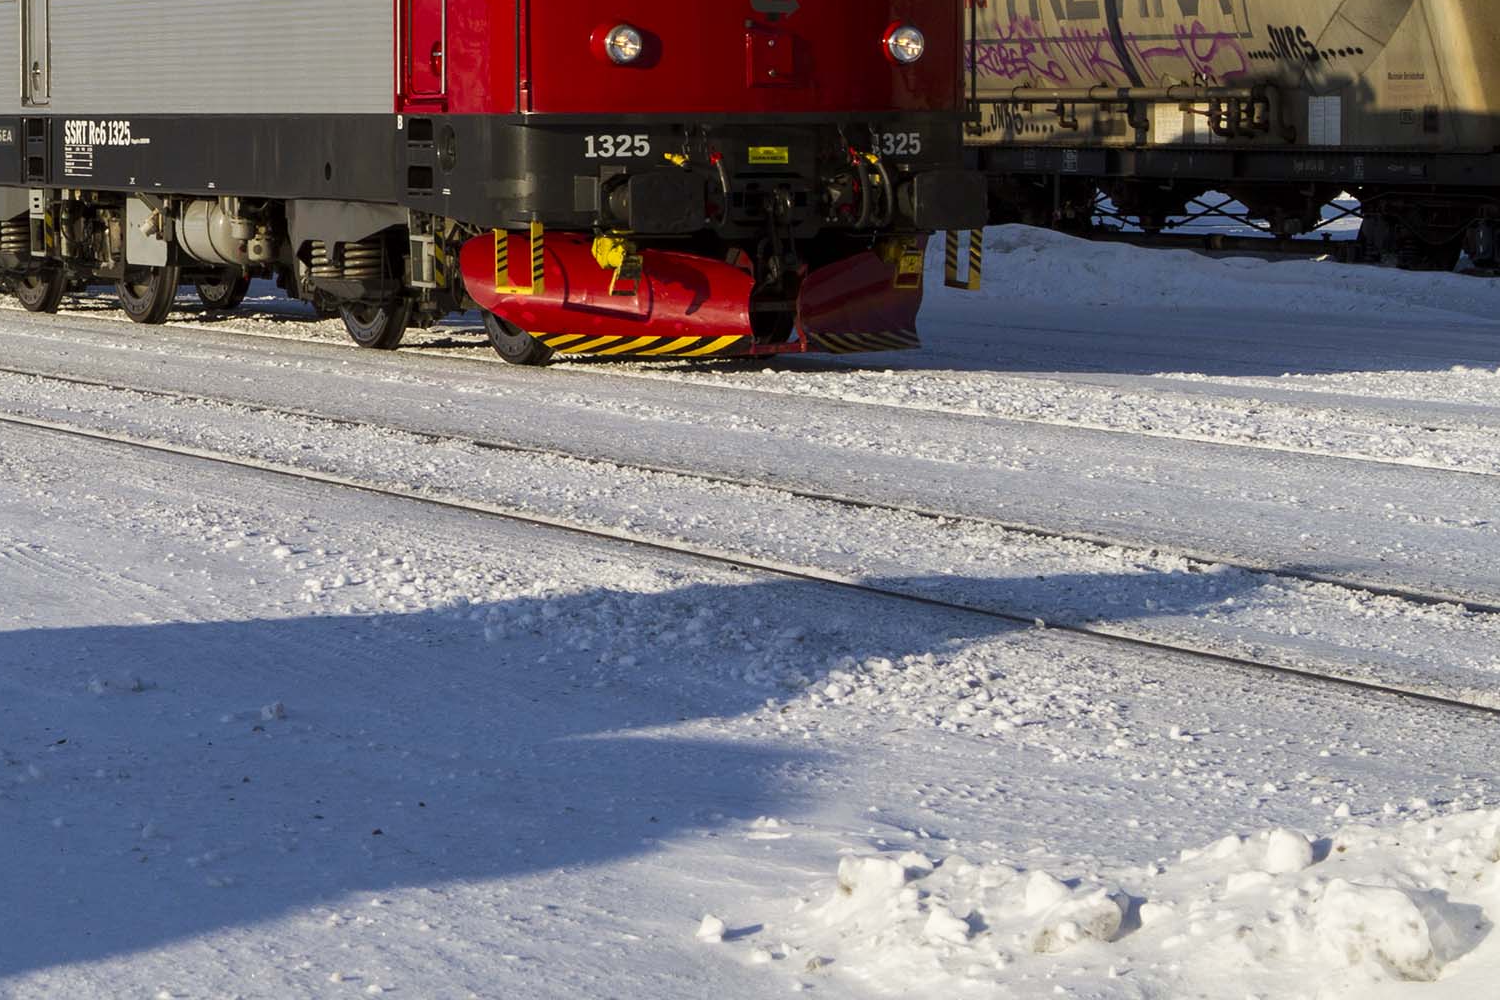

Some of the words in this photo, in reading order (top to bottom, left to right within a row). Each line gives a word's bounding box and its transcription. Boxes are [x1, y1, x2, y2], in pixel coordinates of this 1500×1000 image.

[64, 120, 88, 145] SSRT
[89, 120, 107, 146] Rc6
[108, 120, 131, 146] 1325
[584, 134, 650, 158] 1325
